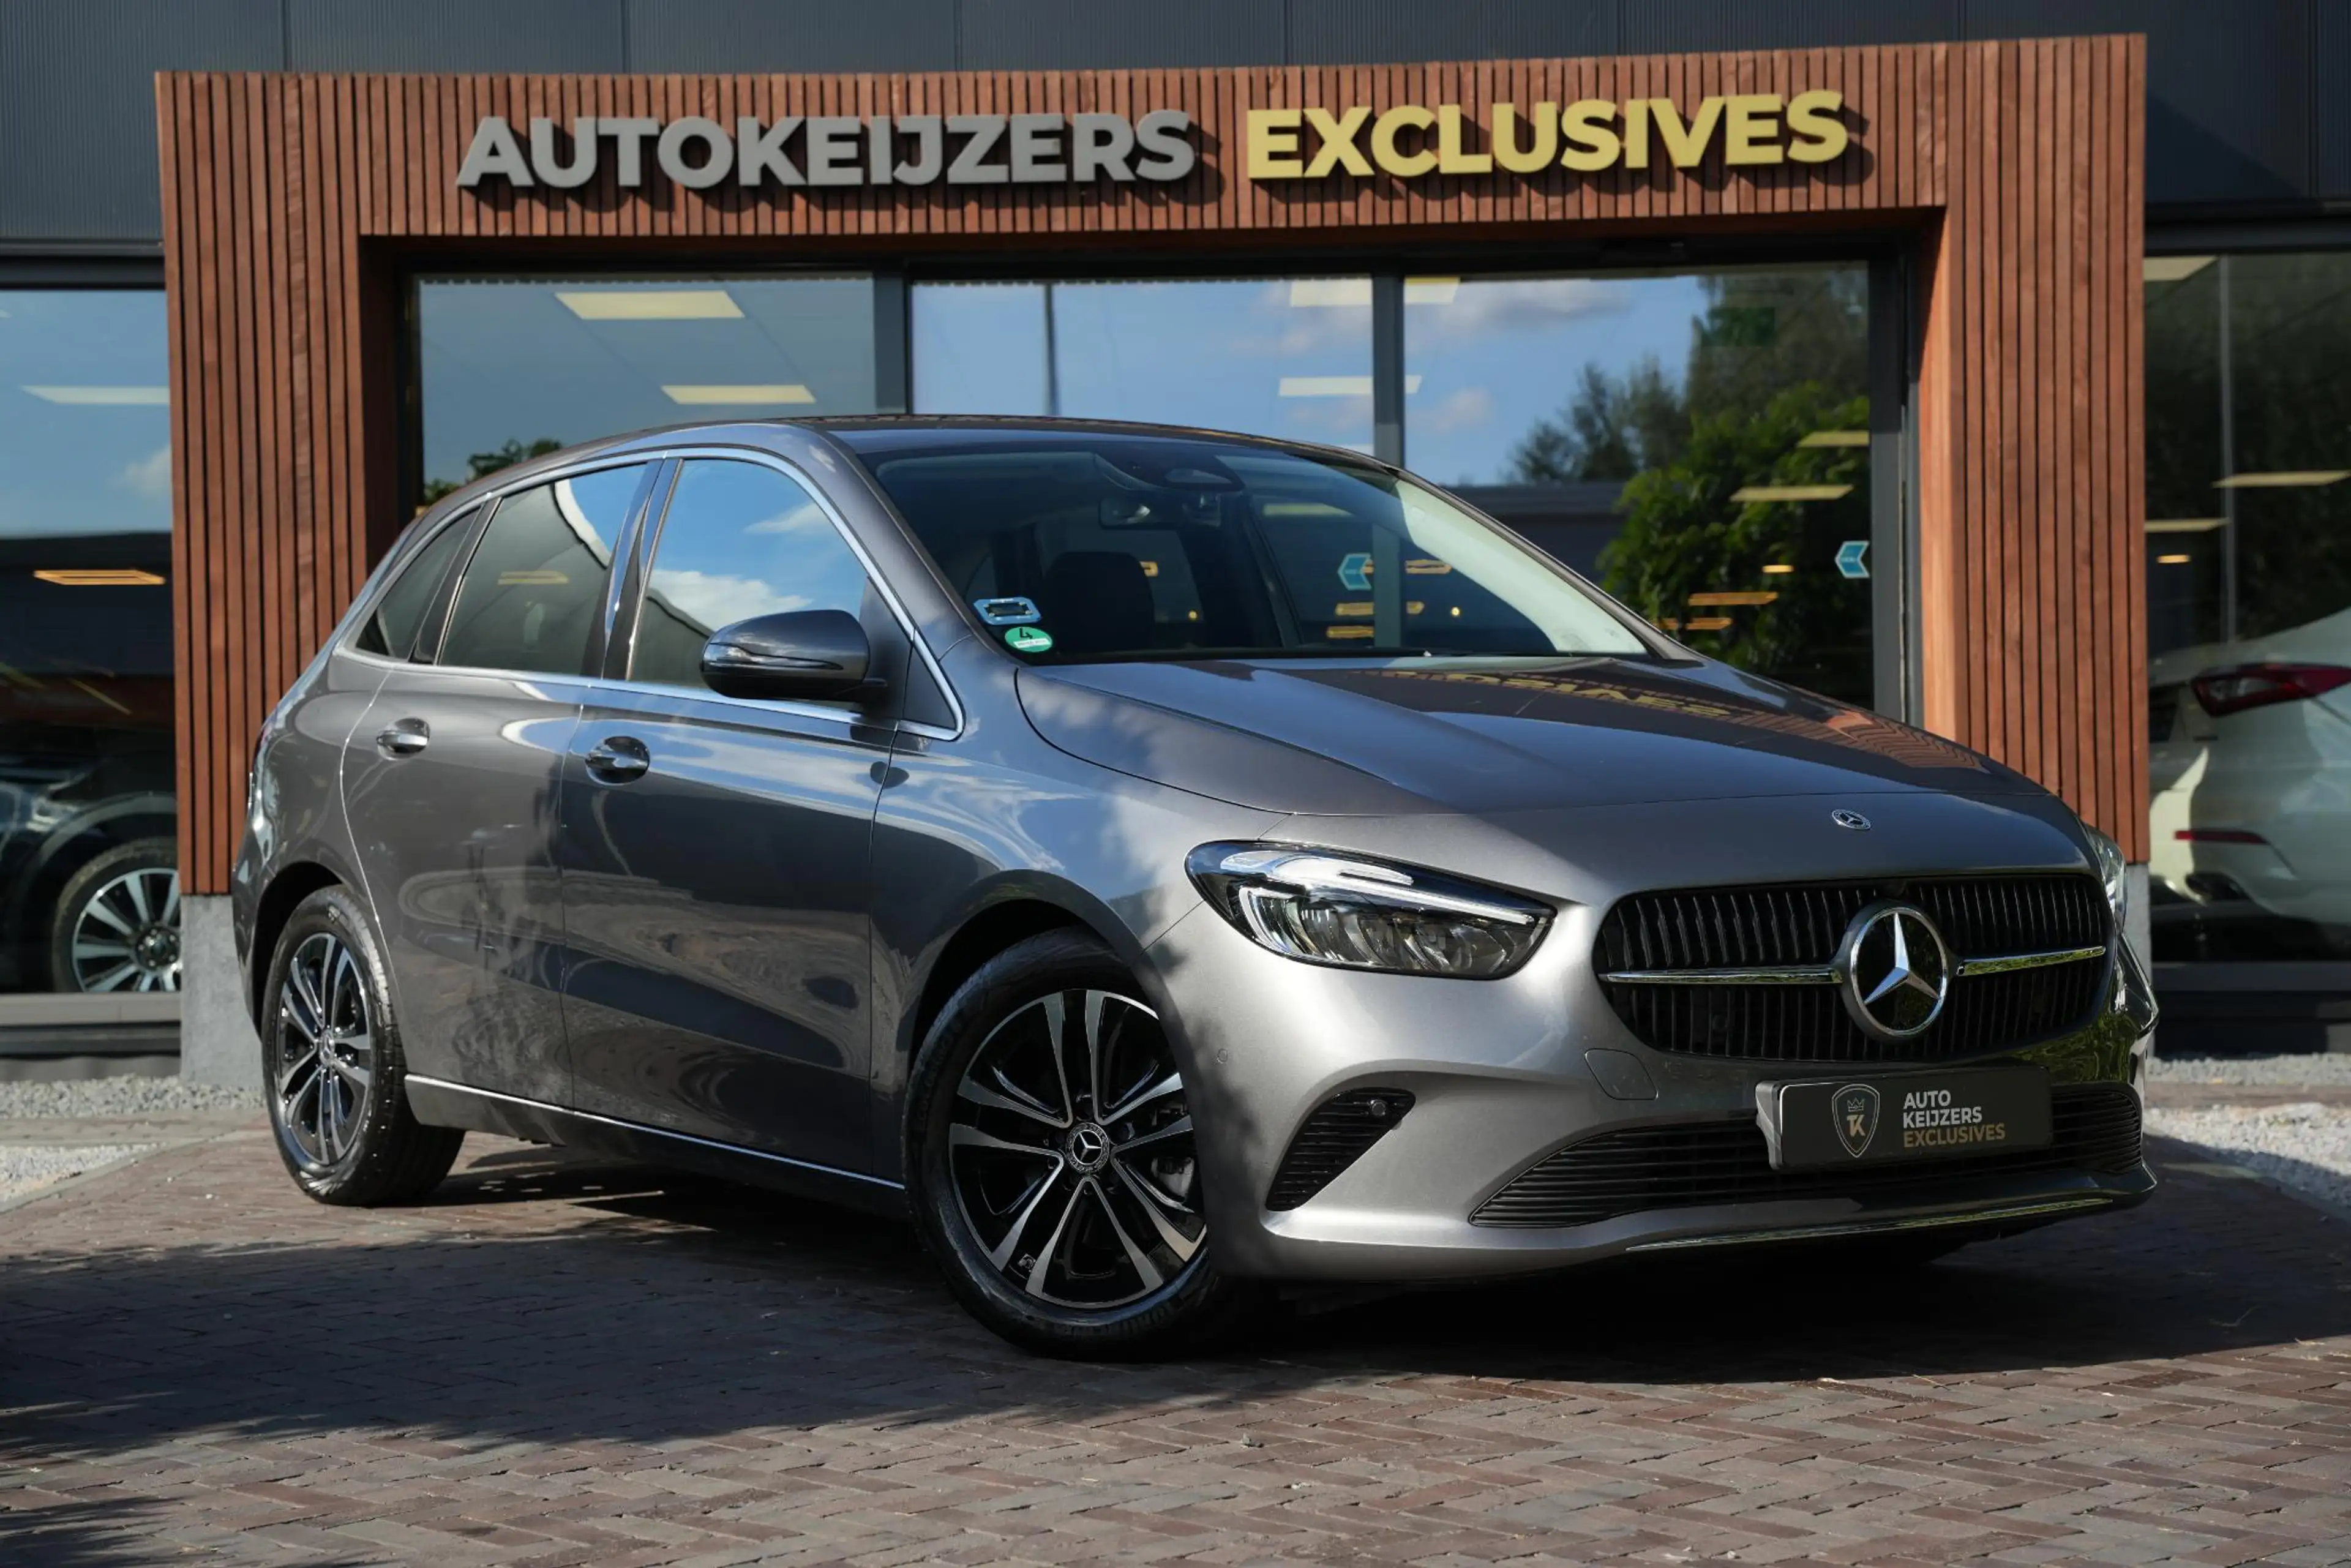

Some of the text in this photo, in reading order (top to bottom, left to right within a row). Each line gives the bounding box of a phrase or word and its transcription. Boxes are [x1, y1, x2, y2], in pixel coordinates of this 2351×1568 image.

[457, 89, 1849, 189] AUTOKEIJZERS EXCLUSIVES
[1903, 1089, 1952, 1109] AUTO
[1903, 1106, 1983, 1129] KEIJZERS
[1903, 1122, 2006, 1148] EXCLUSIVES
